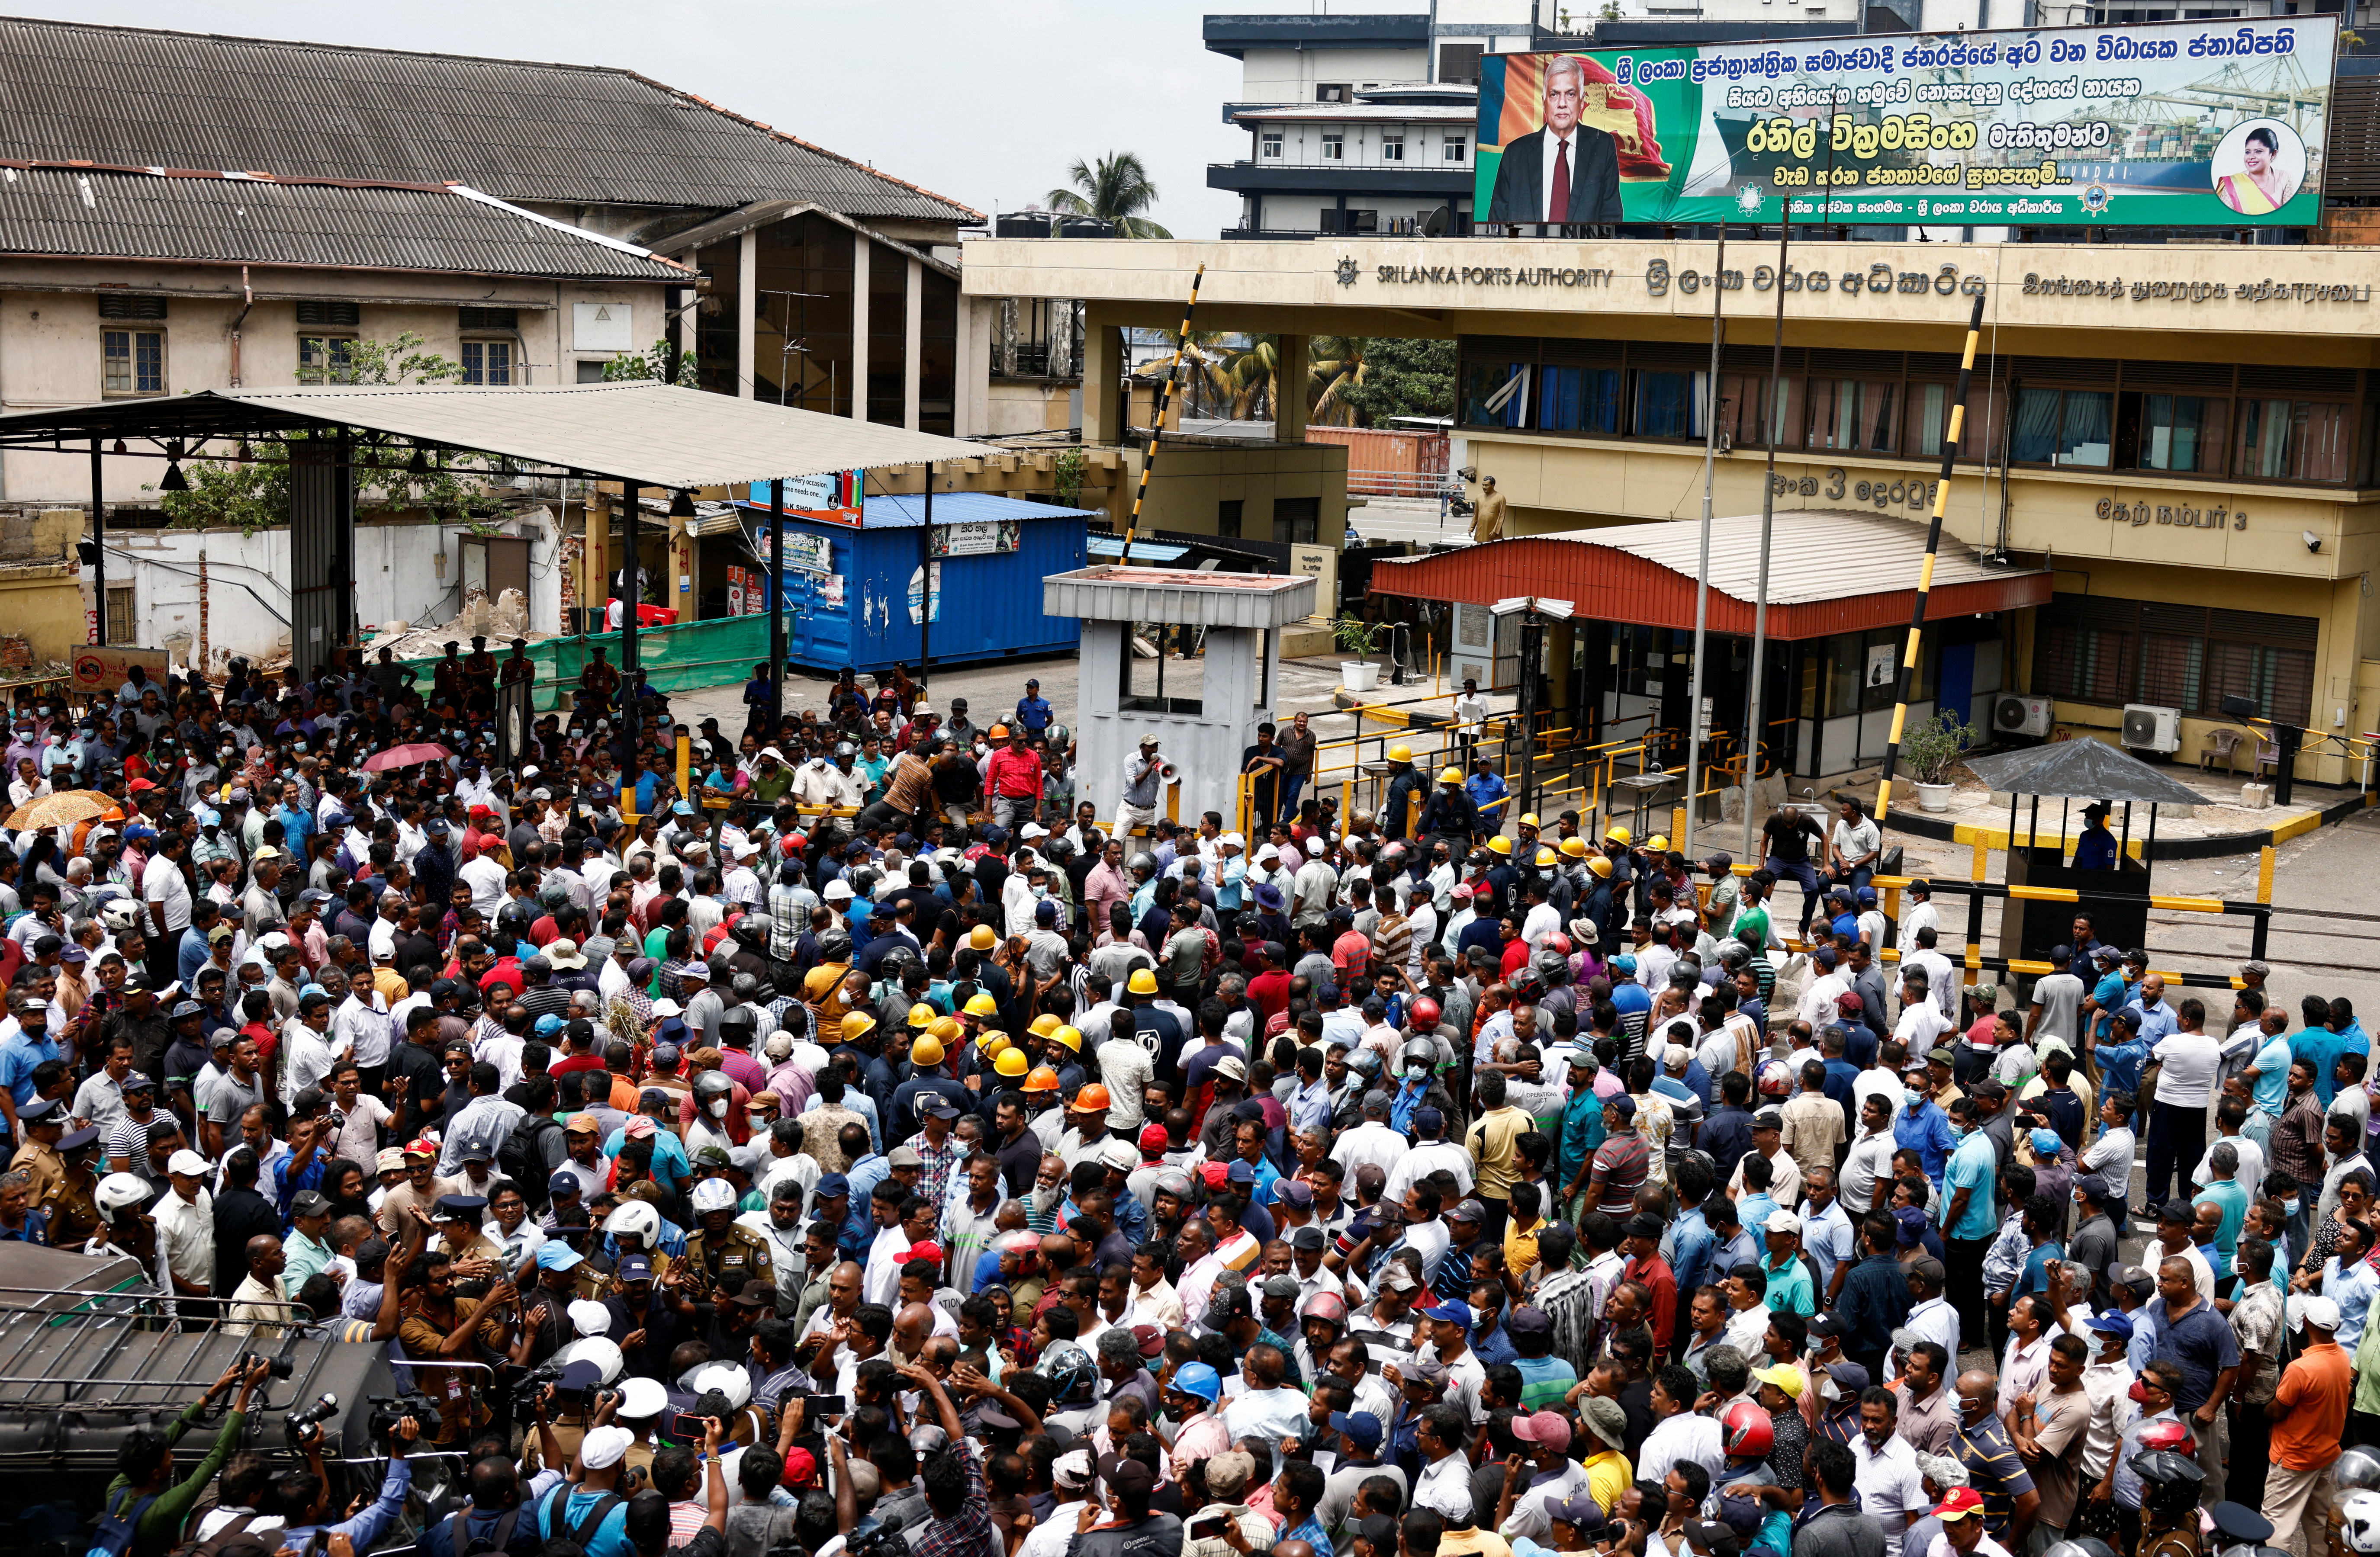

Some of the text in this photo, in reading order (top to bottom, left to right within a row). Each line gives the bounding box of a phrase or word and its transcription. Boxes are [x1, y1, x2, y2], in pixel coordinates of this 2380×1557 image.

[1617, 58, 1632, 84] ශ්‍රී
[1639, 62, 1684, 82] ලංකා
[1807, 45, 1894, 74] සමාජවාදී
[1902, 43, 1996, 67] ජනරජයේ
[2007, 45, 2040, 70] අට
[2051, 43, 2086, 63] වන
[2095, 34, 2178, 60] විධායක
[2188, 28, 2295, 58] ජනාධිපති
[1779, 86, 1850, 108] අභියෝග
[1857, 80, 1909, 106] හමුවේ
[2009, 77, 2076, 104] දේශයේ
[2084, 78, 2140, 96] නායක
[1747, 115, 2109, 158] රනිල් වික්‍රමසිංහ මැතිතුමන්ට
[1774, 167, 1808, 186] වැඩ
[1817, 168, 1859, 185] කරන
[1866, 165, 1960, 186] ජනතාවගේ
[2062, 166, 2126, 179] YUNDAI
[1858, 202, 1903, 214] සංගමය
[1917, 200, 1929, 217] ශ්‍රී
[1933, 202, 1964, 215] ලංකා
[1970, 201, 2002, 214] වරාය
[2008, 200, 2063, 216] අධිකාරිය
[1377, 265, 1614, 287] SRI LANKA PORTS AUTHORITY
[1646, 258, 1987, 297] ශ්‍රී ලංකා වරාය අධිකාරිය
[2022, 273, 2370, 303] இலங்கைத் துறைமுக அதிகாரசபை
[794, 487, 809, 495] needs
[806, 480, 828, 489] occasion,
[1773, 475, 1818, 497] අංක
[1826, 468, 1846, 500] 3
[796, 504, 813, 514] SHOP
[2234, 512, 2247, 530] 3
[961, 525, 973, 533] කිරි
[114, 672, 157, 681] Photphy
[551, 872, 567, 883] PERATION
[701, 1194, 729, 1204] POLICE
[939, 1298, 961, 1309] ATION
[666, 1403, 685, 1414] STICS
